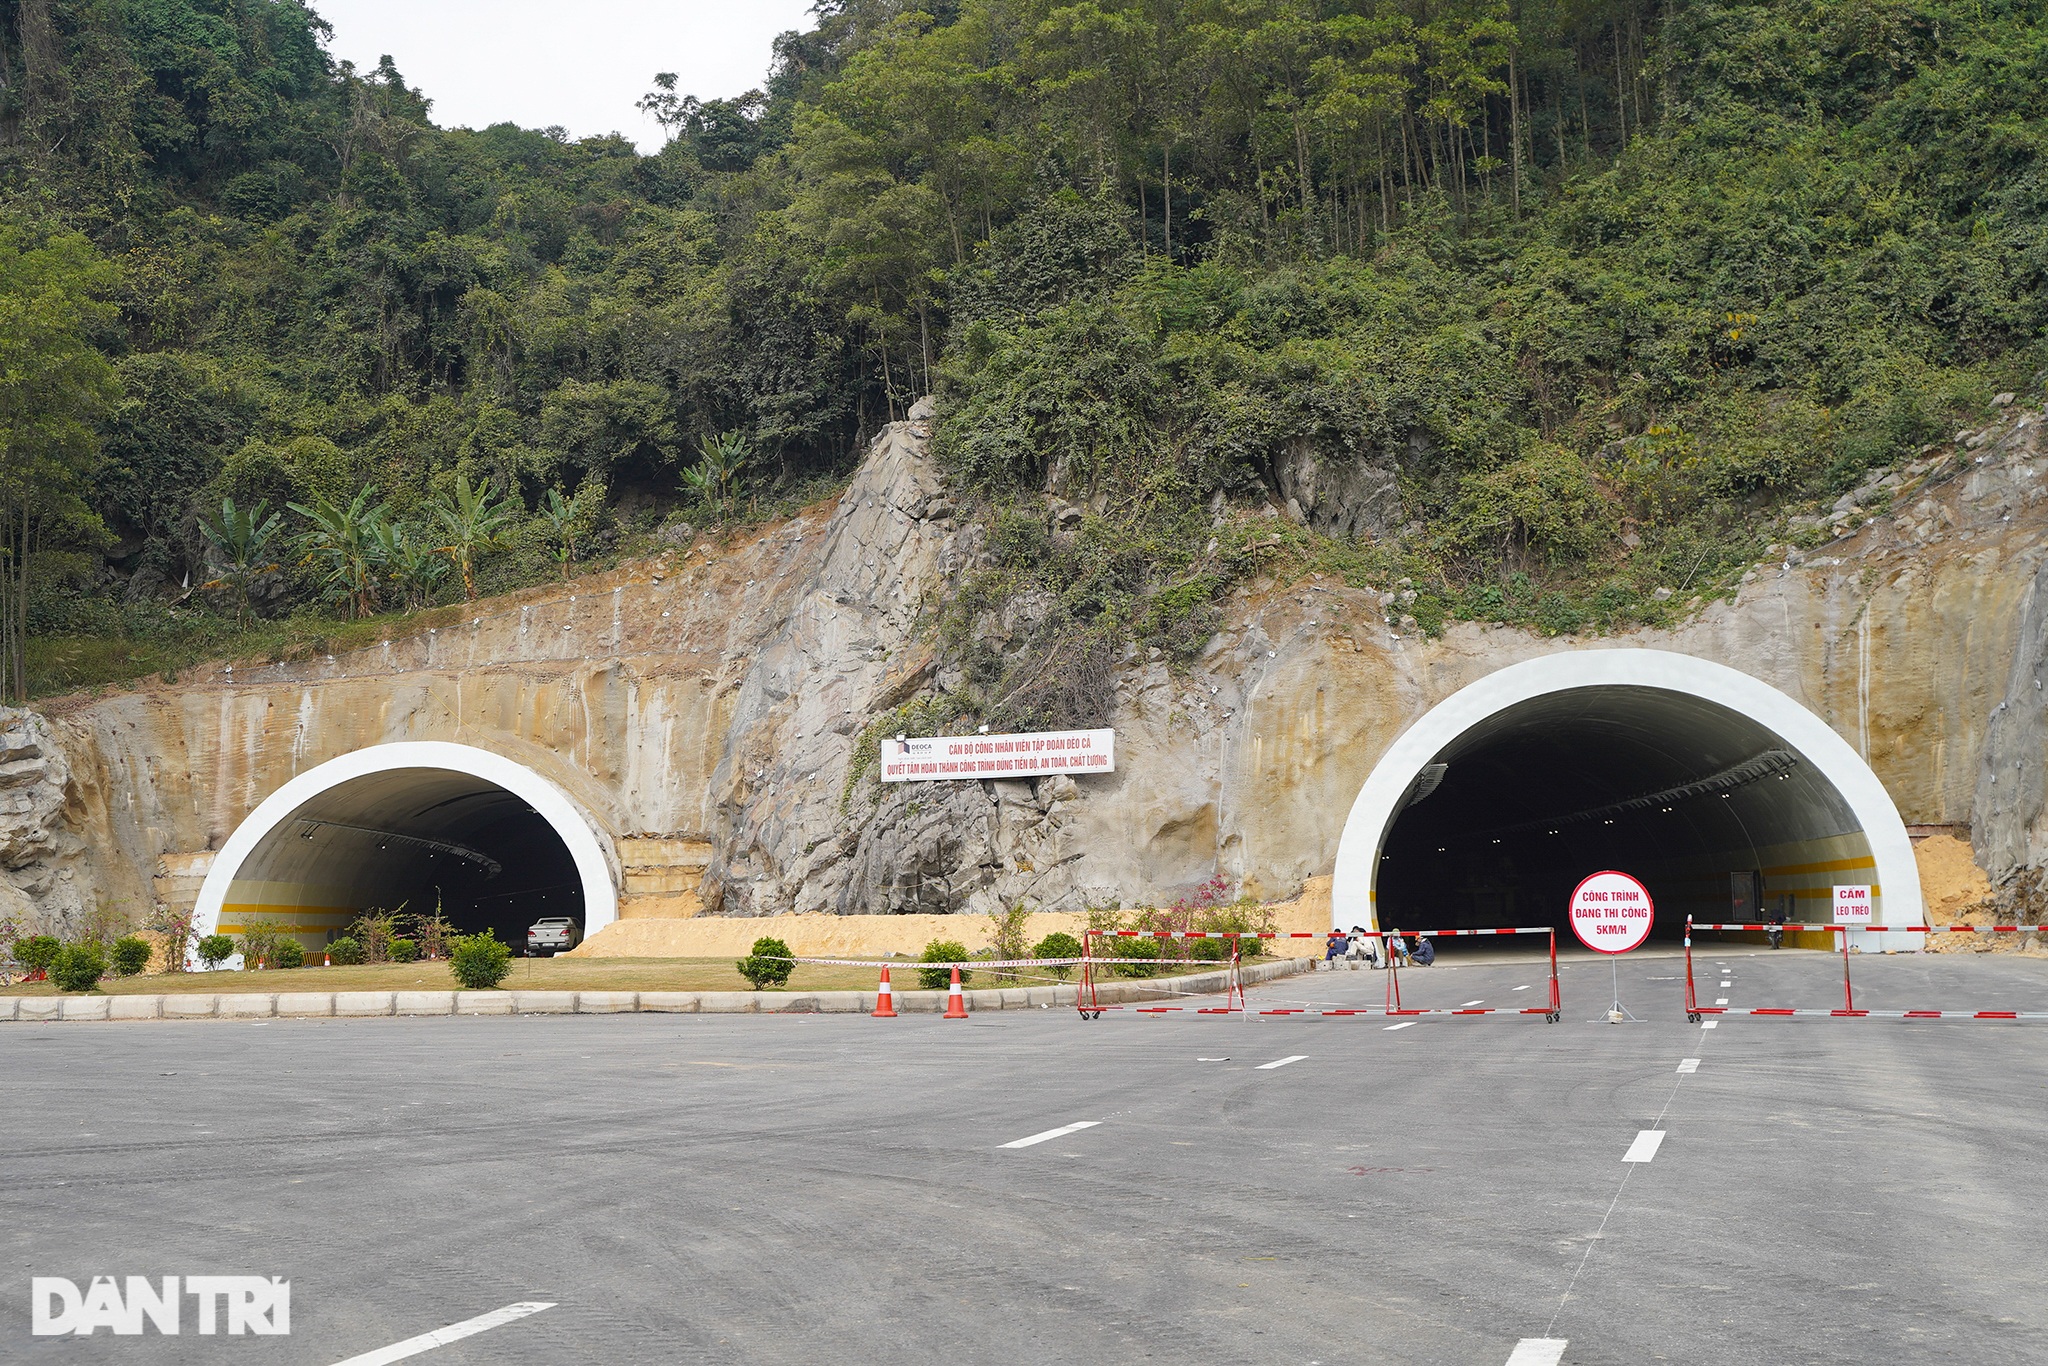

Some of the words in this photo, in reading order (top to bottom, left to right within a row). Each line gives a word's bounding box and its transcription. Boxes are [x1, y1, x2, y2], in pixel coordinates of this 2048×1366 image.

[949, 742, 963, 755] CÁN
[964, 742, 974, 756] BỘ
[975, 741, 993, 754] CÔNG
[995, 740, 1014, 753] NHÂN
[1015, 739, 1031, 752] VIÊN
[1032, 738, 1045, 753] TẬP
[1046, 737, 1065, 751] ĐOÀN
[1081, 734, 1091, 749] CẢ
[887, 761, 906, 776] QUYẾT
[907, 761, 920, 774] TÂM
[921, 761, 938, 774] HOÀN
[939, 760, 959, 773] THÀNH
[960, 759, 976, 772] CÔNG
[977, 759, 995, 772] TRÌNH
[996, 758, 1013, 771] ĐÚNG
[1014, 755, 1028, 770] TIẾN
[1040, 757, 1050, 769] AN
[1070, 752, 1086, 767] CHẤT
[1087, 754, 1108, 768] LƯỢNG
[1582, 890, 1608, 902] CÔNG
[1611, 889, 1639, 902] TRÌNH
[1840, 887, 1865, 899] CẤM
[1575, 908, 1601, 918] ĐANG
[1604, 908, 1619, 918] THI
[1621, 906, 1648, 918] CÔNG
[1836, 906, 1849, 916] LEO
[1851, 904, 1870, 916] TRÈO
[1596, 925, 1627, 935] 5KM/H
